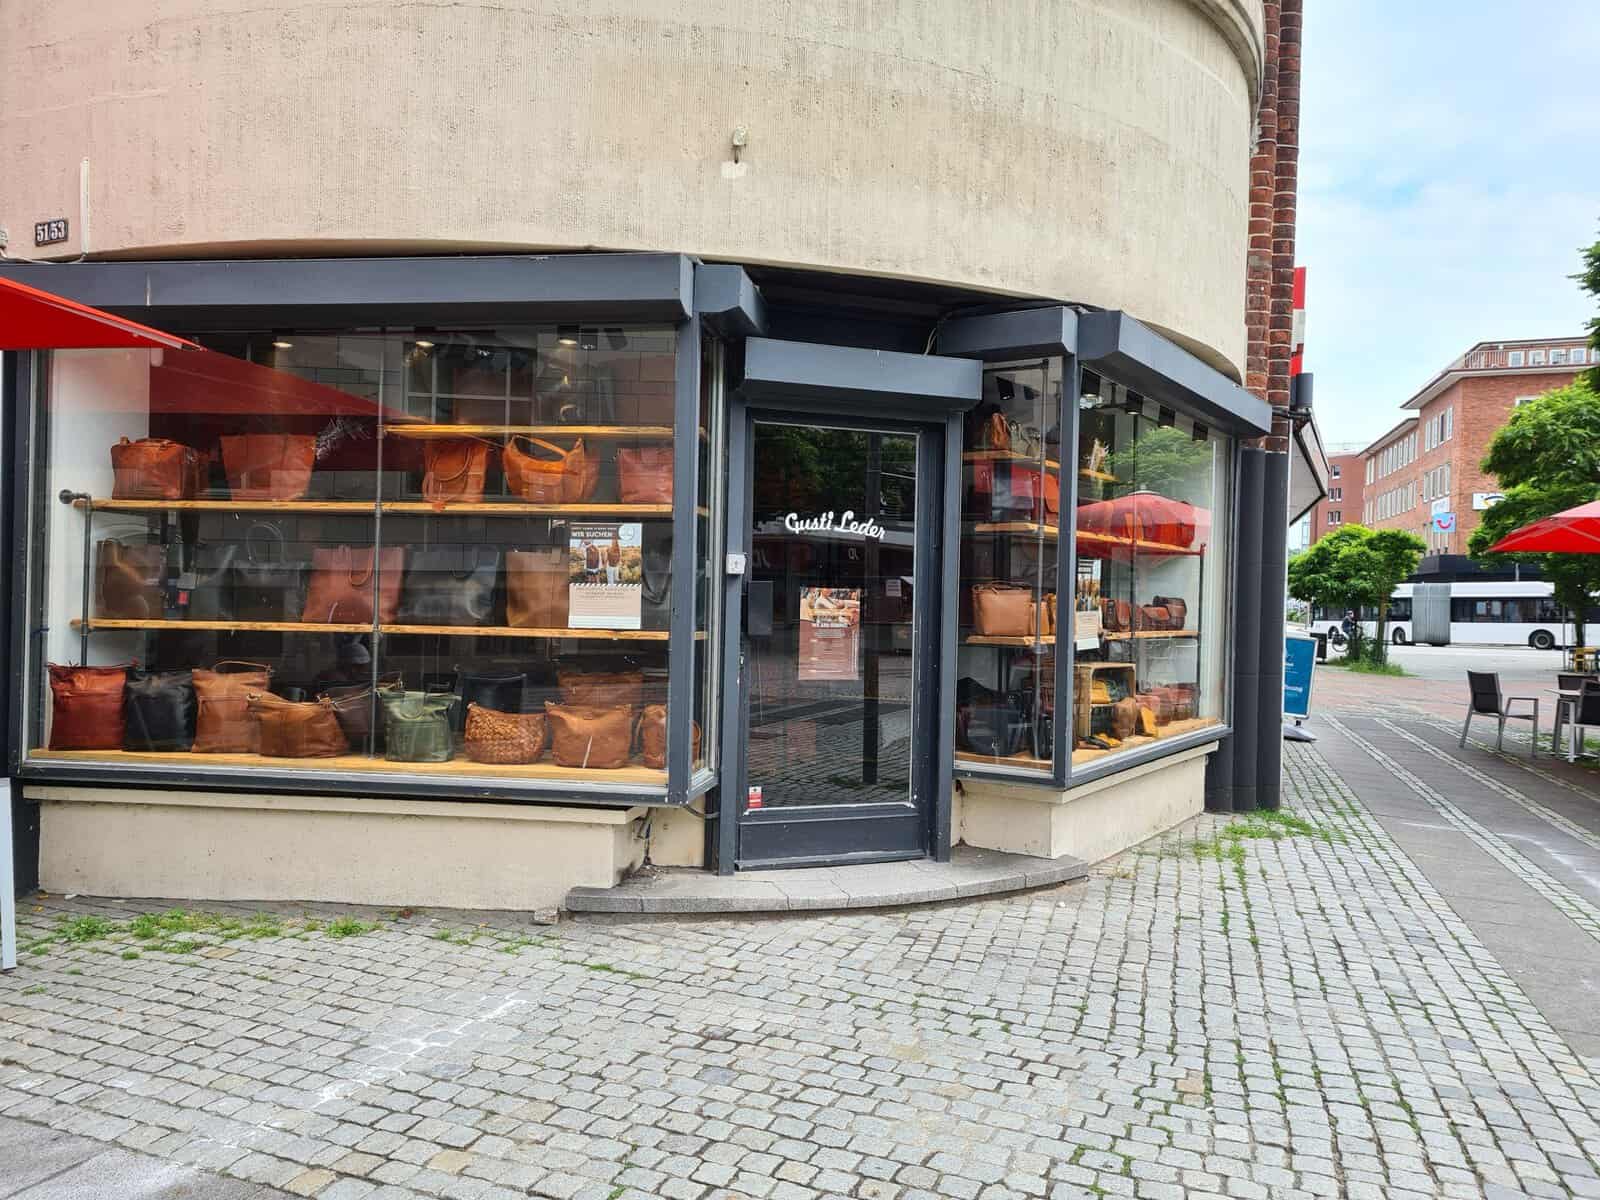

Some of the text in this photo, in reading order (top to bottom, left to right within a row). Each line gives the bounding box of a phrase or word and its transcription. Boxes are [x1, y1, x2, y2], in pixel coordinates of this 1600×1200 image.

[785, 510, 886, 539] Gusti Leder
[586, 530, 613, 538] SUCHEN
